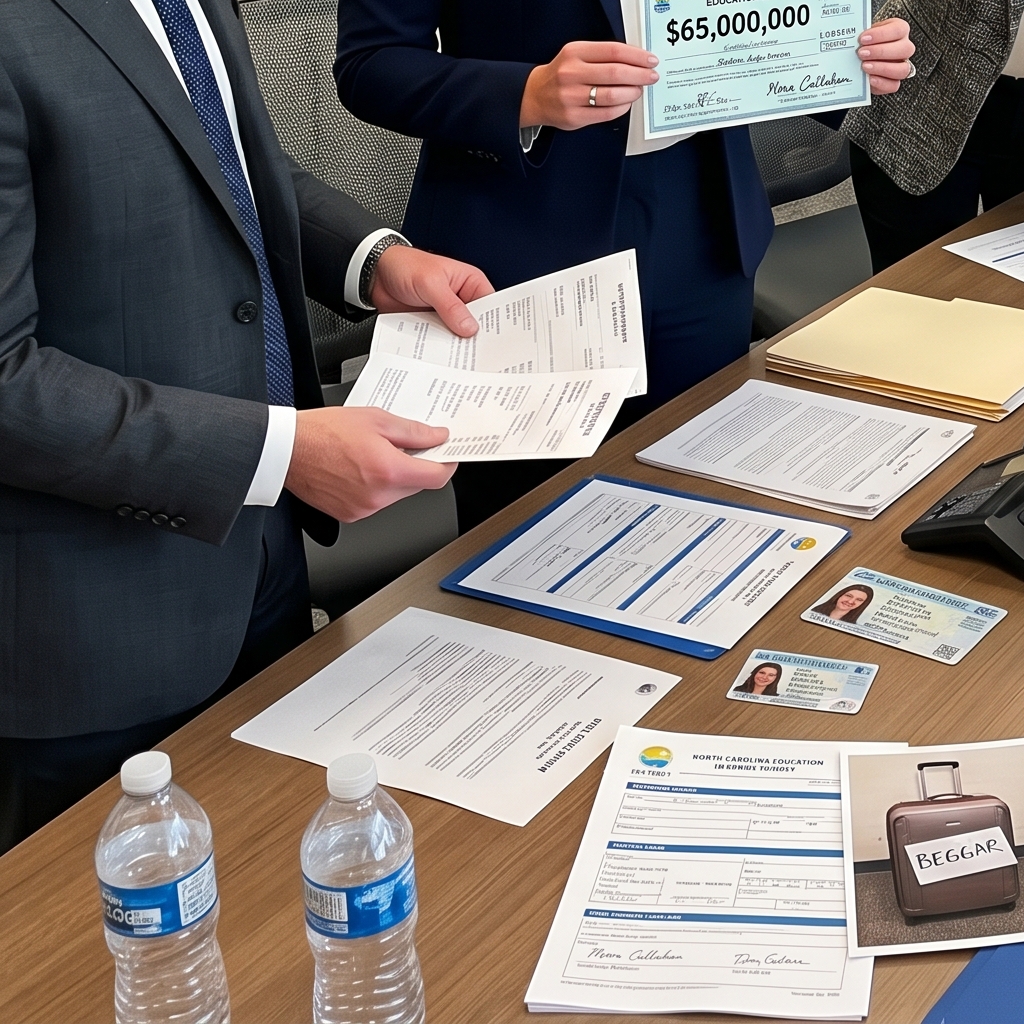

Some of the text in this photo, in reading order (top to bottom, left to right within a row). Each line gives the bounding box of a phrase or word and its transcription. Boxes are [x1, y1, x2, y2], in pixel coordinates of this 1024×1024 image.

[666, 4, 810, 46] $65,000,000
[691, 754, 723, 762] NORTH
[915, 839, 1004, 870] BEGGAR
